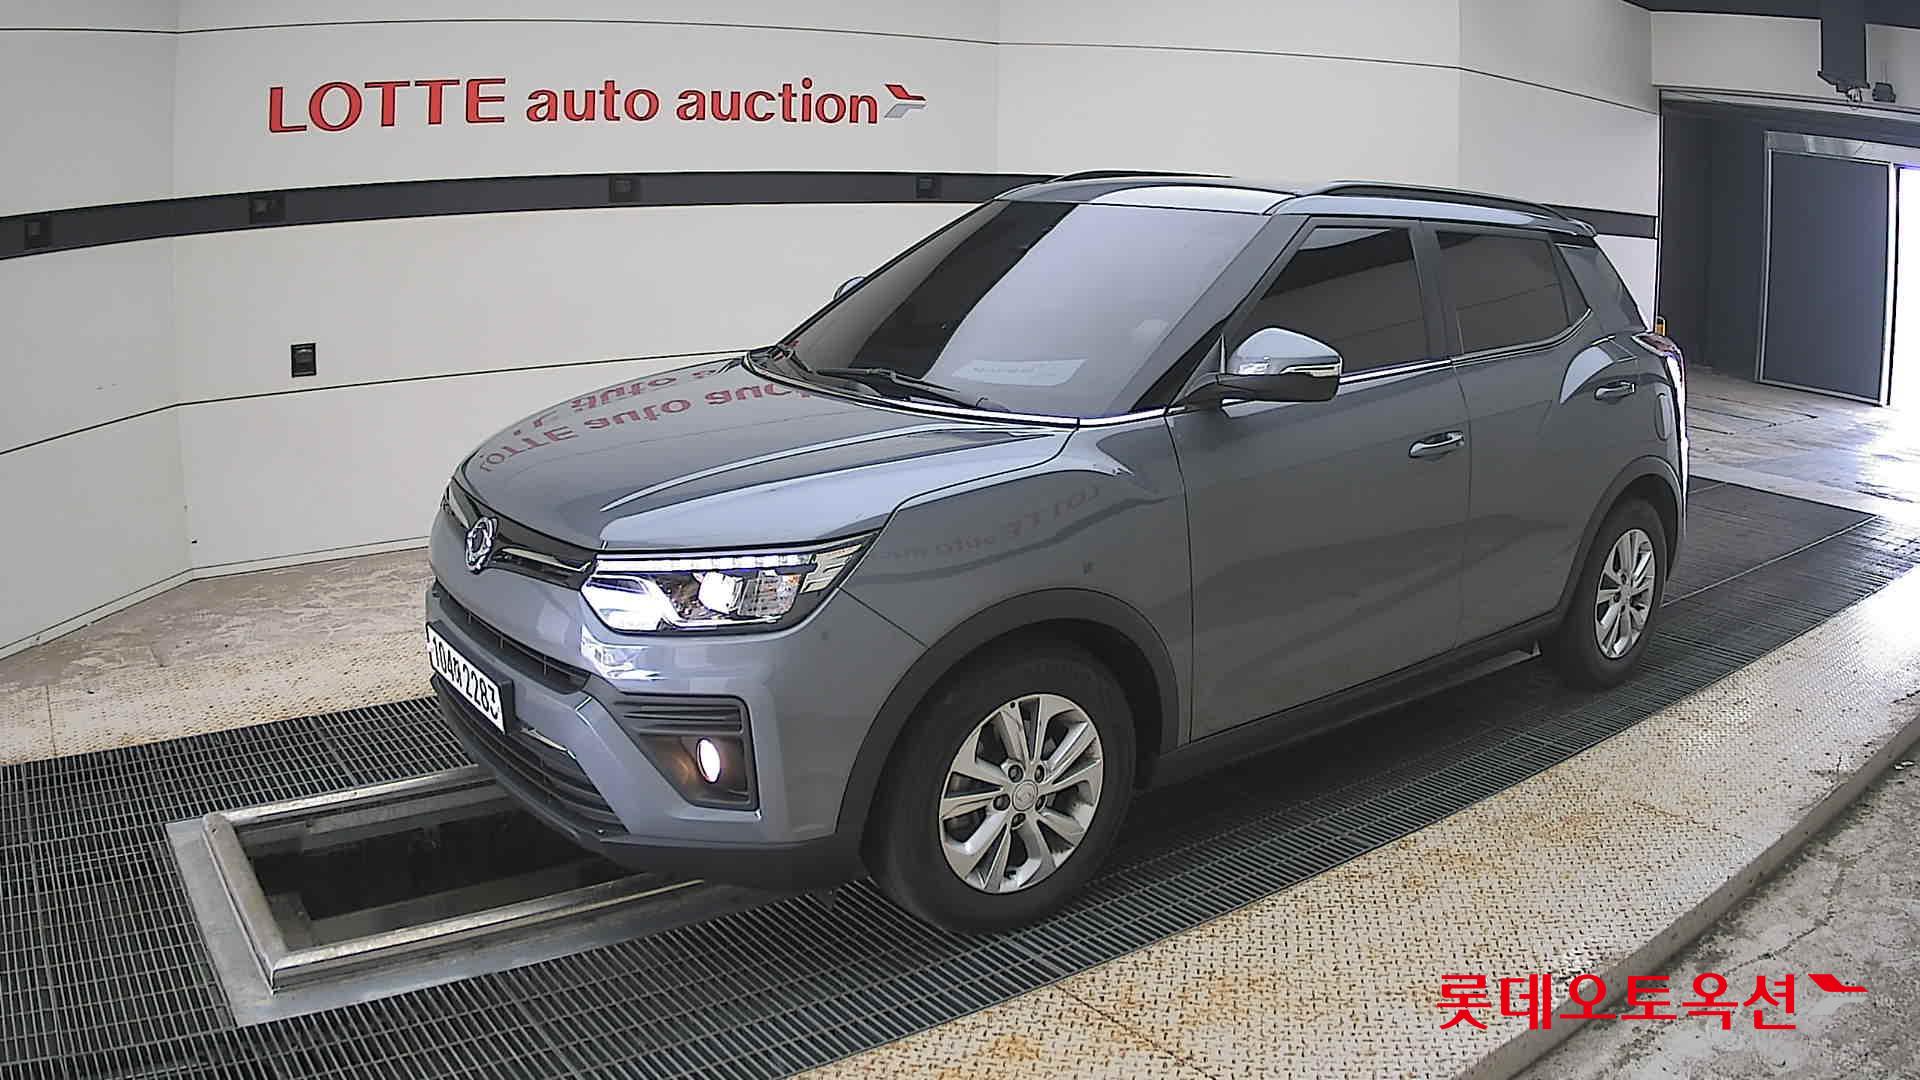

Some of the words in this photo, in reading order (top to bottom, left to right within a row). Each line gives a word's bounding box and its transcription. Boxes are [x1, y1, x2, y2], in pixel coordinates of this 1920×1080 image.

[268, 78, 506, 134] LOTTE
[526, 80, 660, 122] auto
[675, 78, 879, 124] auction
